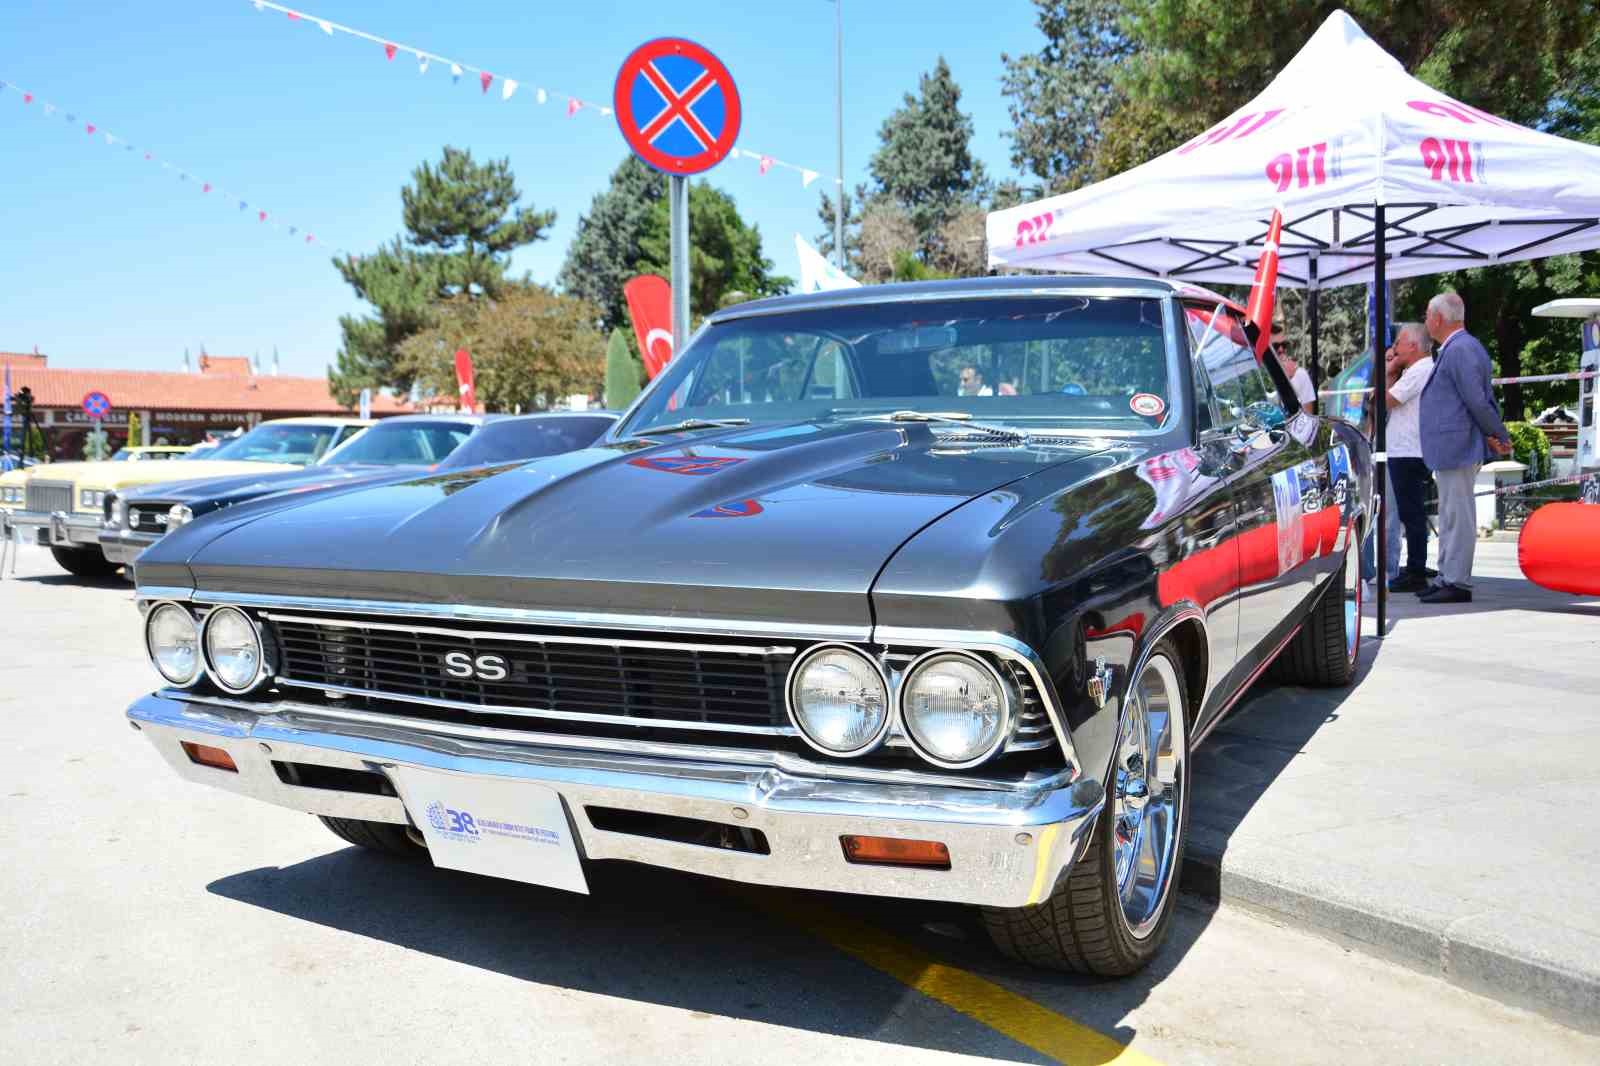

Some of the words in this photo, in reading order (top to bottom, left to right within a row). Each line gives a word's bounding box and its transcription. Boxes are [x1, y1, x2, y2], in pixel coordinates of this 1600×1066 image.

[1265, 142, 1327, 192] 911
[1420, 137, 1473, 182] 911
[445, 652, 506, 680] SS
